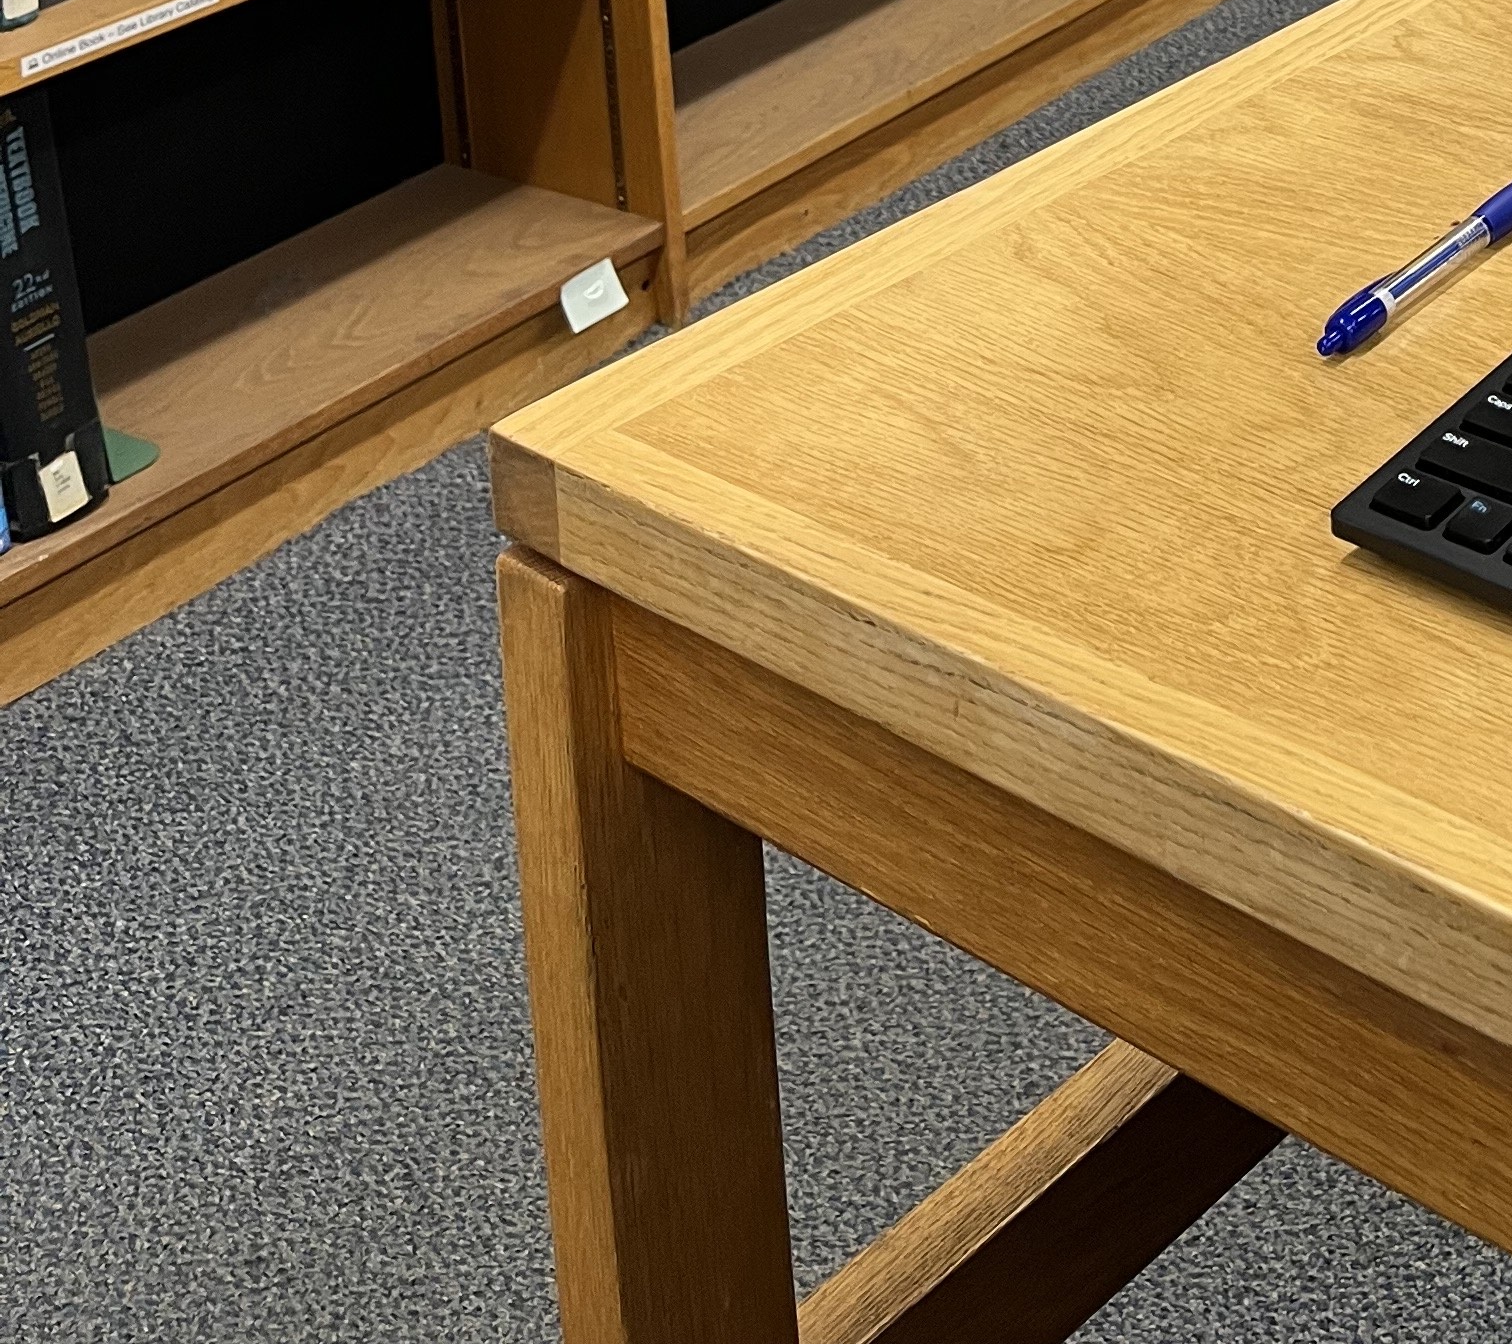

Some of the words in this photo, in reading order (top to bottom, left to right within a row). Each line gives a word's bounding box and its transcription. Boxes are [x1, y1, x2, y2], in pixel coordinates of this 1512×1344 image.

[41, 44, 76, 64] Online
[78, 34, 104, 51] Book
[140, 7, 175, 27] Library
[1487, 394, 1512, 413] Caps
[1442, 432, 1469, 448] Shift
[1398, 473, 1420, 486] Ctrl
